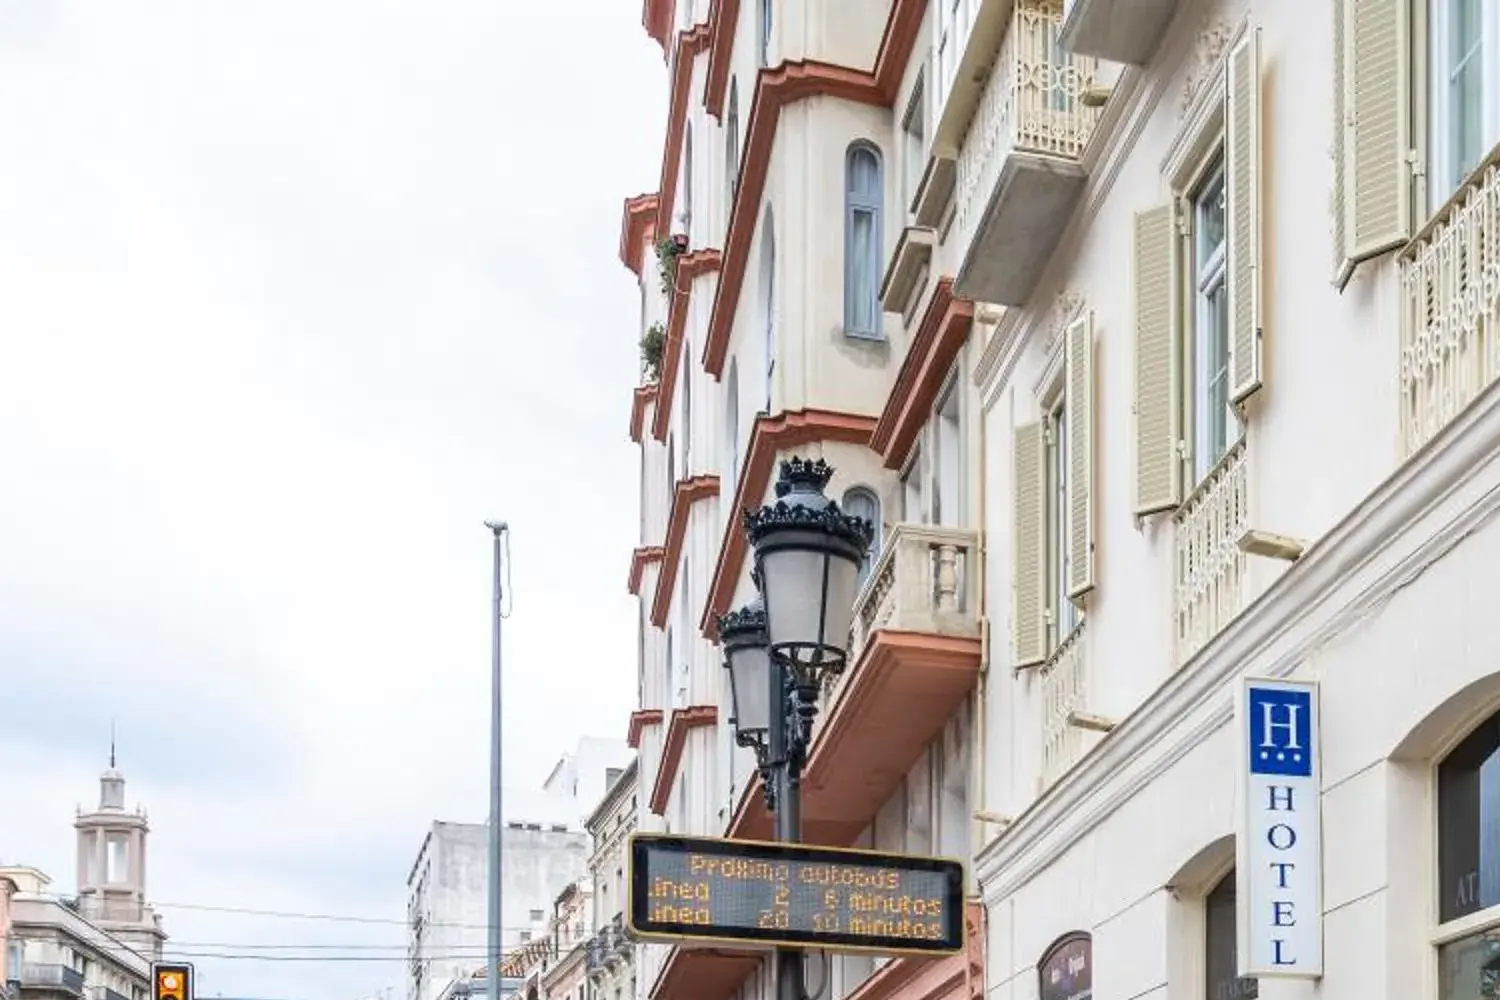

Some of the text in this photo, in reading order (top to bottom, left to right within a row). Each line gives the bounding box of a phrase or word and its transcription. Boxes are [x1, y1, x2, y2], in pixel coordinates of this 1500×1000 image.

[1258, 701, 1302, 749] H
[1267, 785, 1297, 966] HOTEL
[849, 892, 942, 916] minutos
[849, 917, 942, 940] minutos
